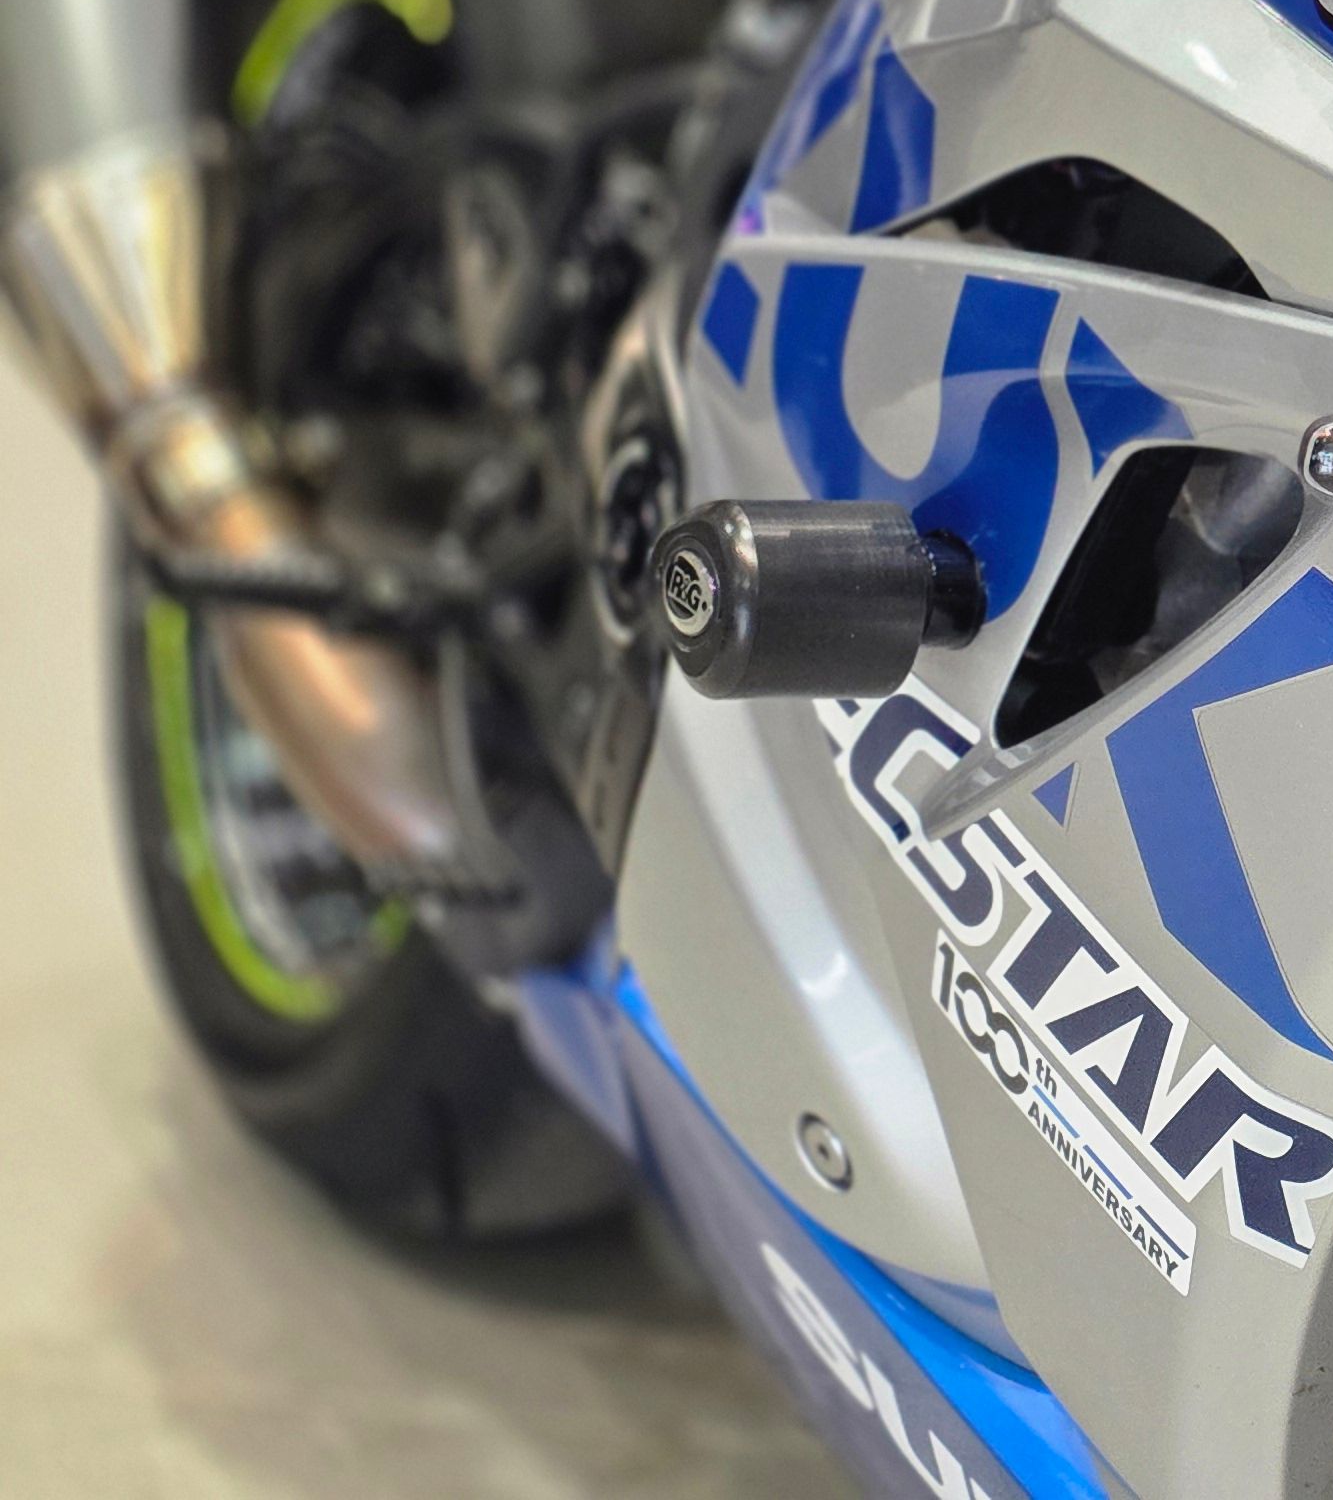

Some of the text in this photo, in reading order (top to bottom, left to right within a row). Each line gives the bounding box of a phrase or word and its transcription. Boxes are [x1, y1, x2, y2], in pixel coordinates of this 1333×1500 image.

[670, 568, 703, 613] R&G
[1026, 1100, 1179, 1279] ANNIVERSARY
[760, 1241, 992, 1500] SU
